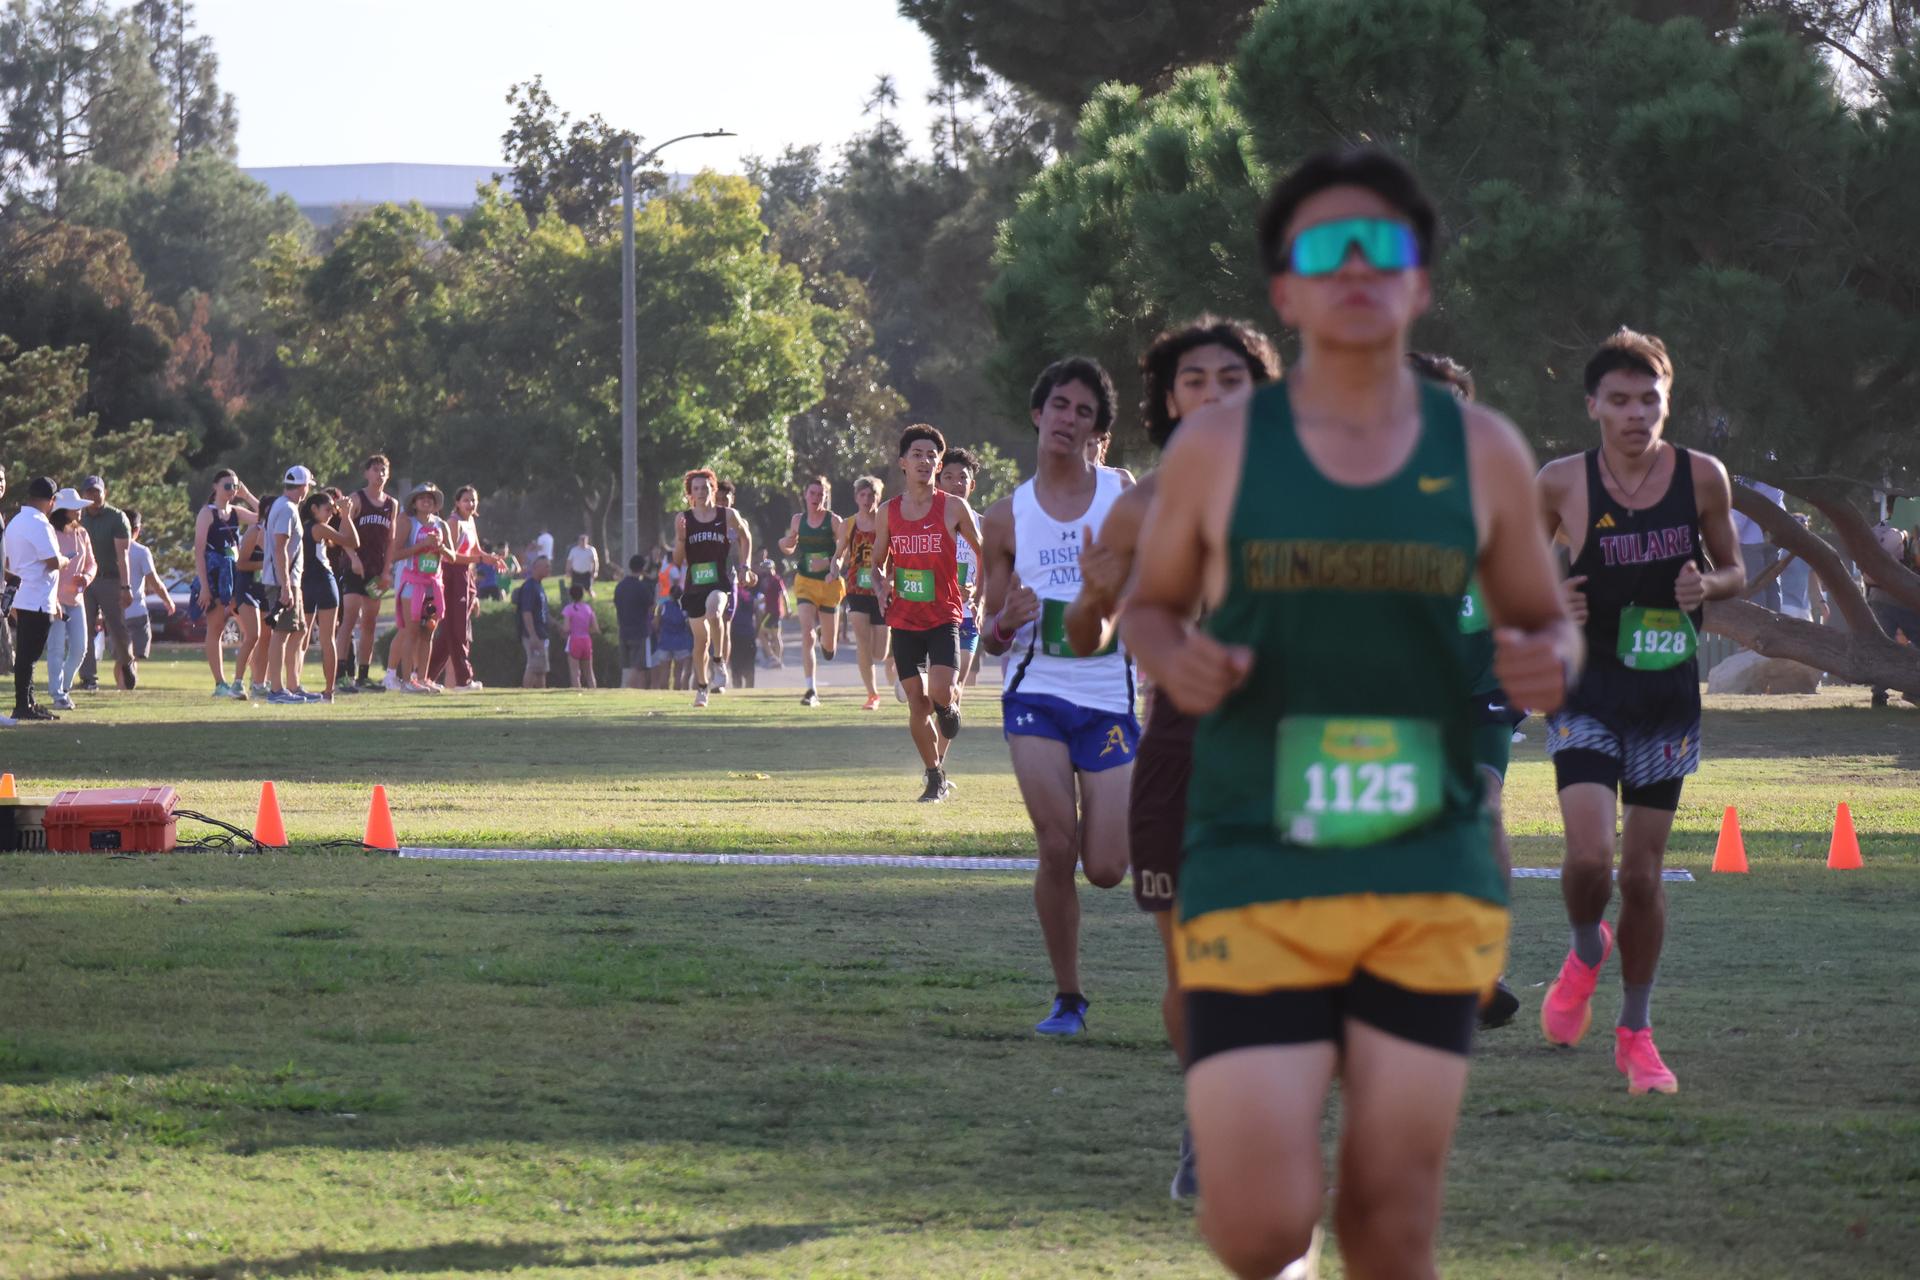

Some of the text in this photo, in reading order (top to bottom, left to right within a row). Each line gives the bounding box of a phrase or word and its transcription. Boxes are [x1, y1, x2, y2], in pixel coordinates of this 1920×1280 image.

[891, 533, 942, 554] TRIBE
[1600, 525, 1692, 566] TULARE
[1039, 545, 1081, 567] BISH
[903, 580, 924, 593] 281
[1049, 567, 1084, 585] AM
[1461, 594, 1473, 617] 3
[1631, 629, 1687, 654] 1928
[1303, 761, 1419, 816] 1125
[1141, 869, 1173, 899] DO
